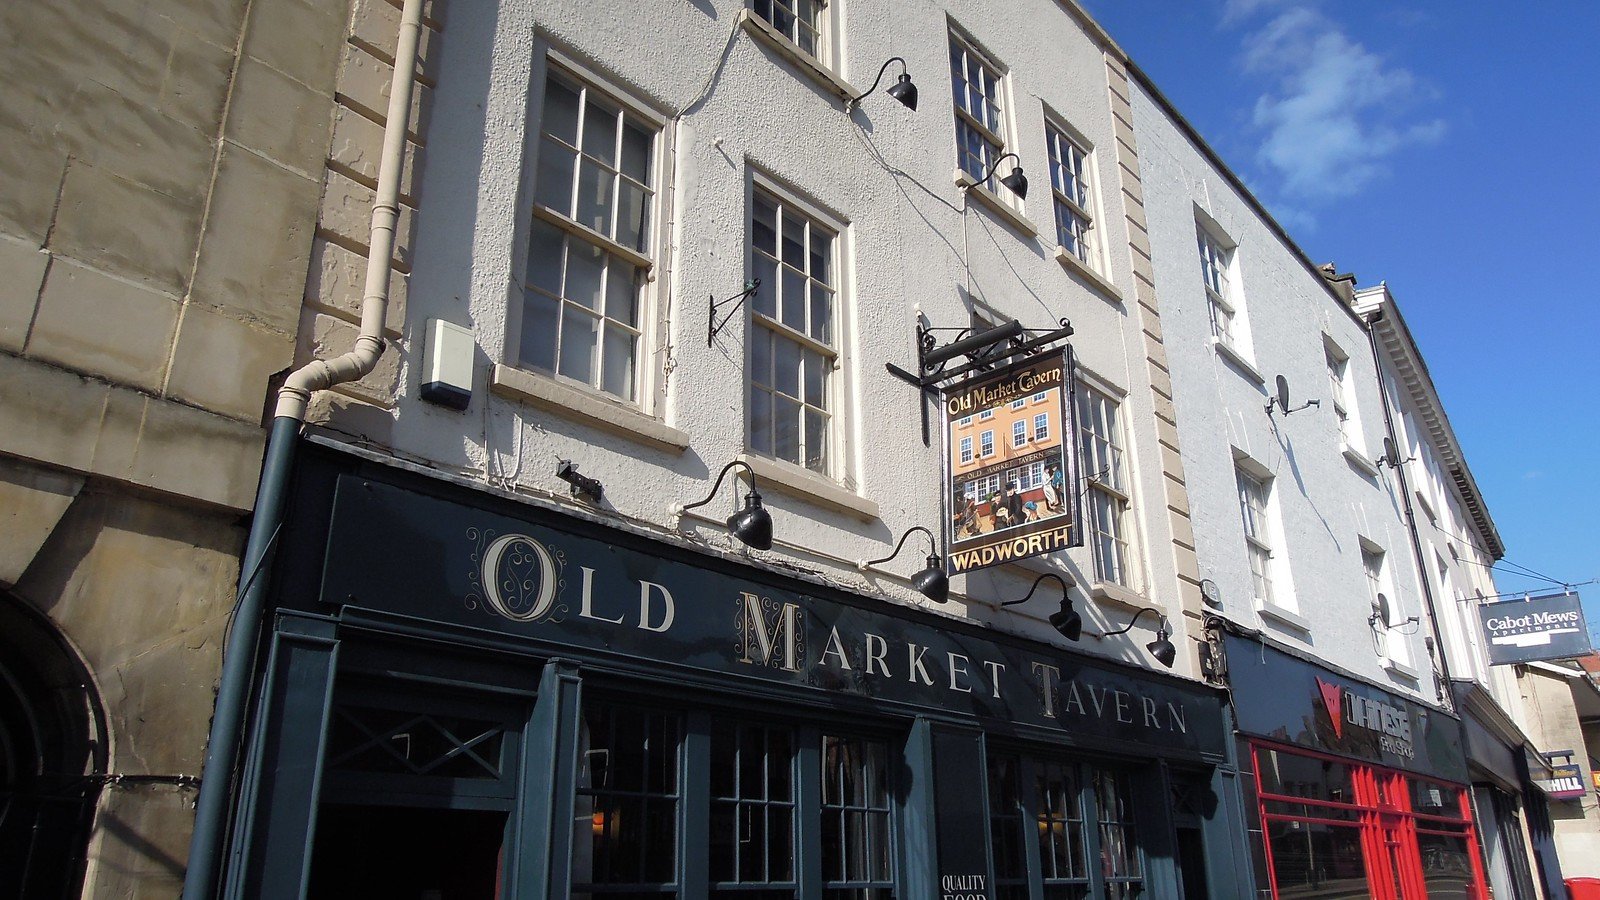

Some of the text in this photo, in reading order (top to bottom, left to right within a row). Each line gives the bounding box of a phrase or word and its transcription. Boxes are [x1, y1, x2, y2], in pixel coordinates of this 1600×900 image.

[948, 367, 1061, 416] Old Market Tavern
[967, 470, 982, 480] OLD
[1018, 451, 1045, 465] TAVERN
[952, 528, 1069, 572] WADWORTH
[1486, 611, 1579, 631] Cabot Mews
[1492, 622, 1577, 637] Apartments
[480, 533, 1187, 734] OLD MARKET TAVERN
[1551, 777, 1583, 792] HILL
[942, 874, 986, 893] QUALITY
